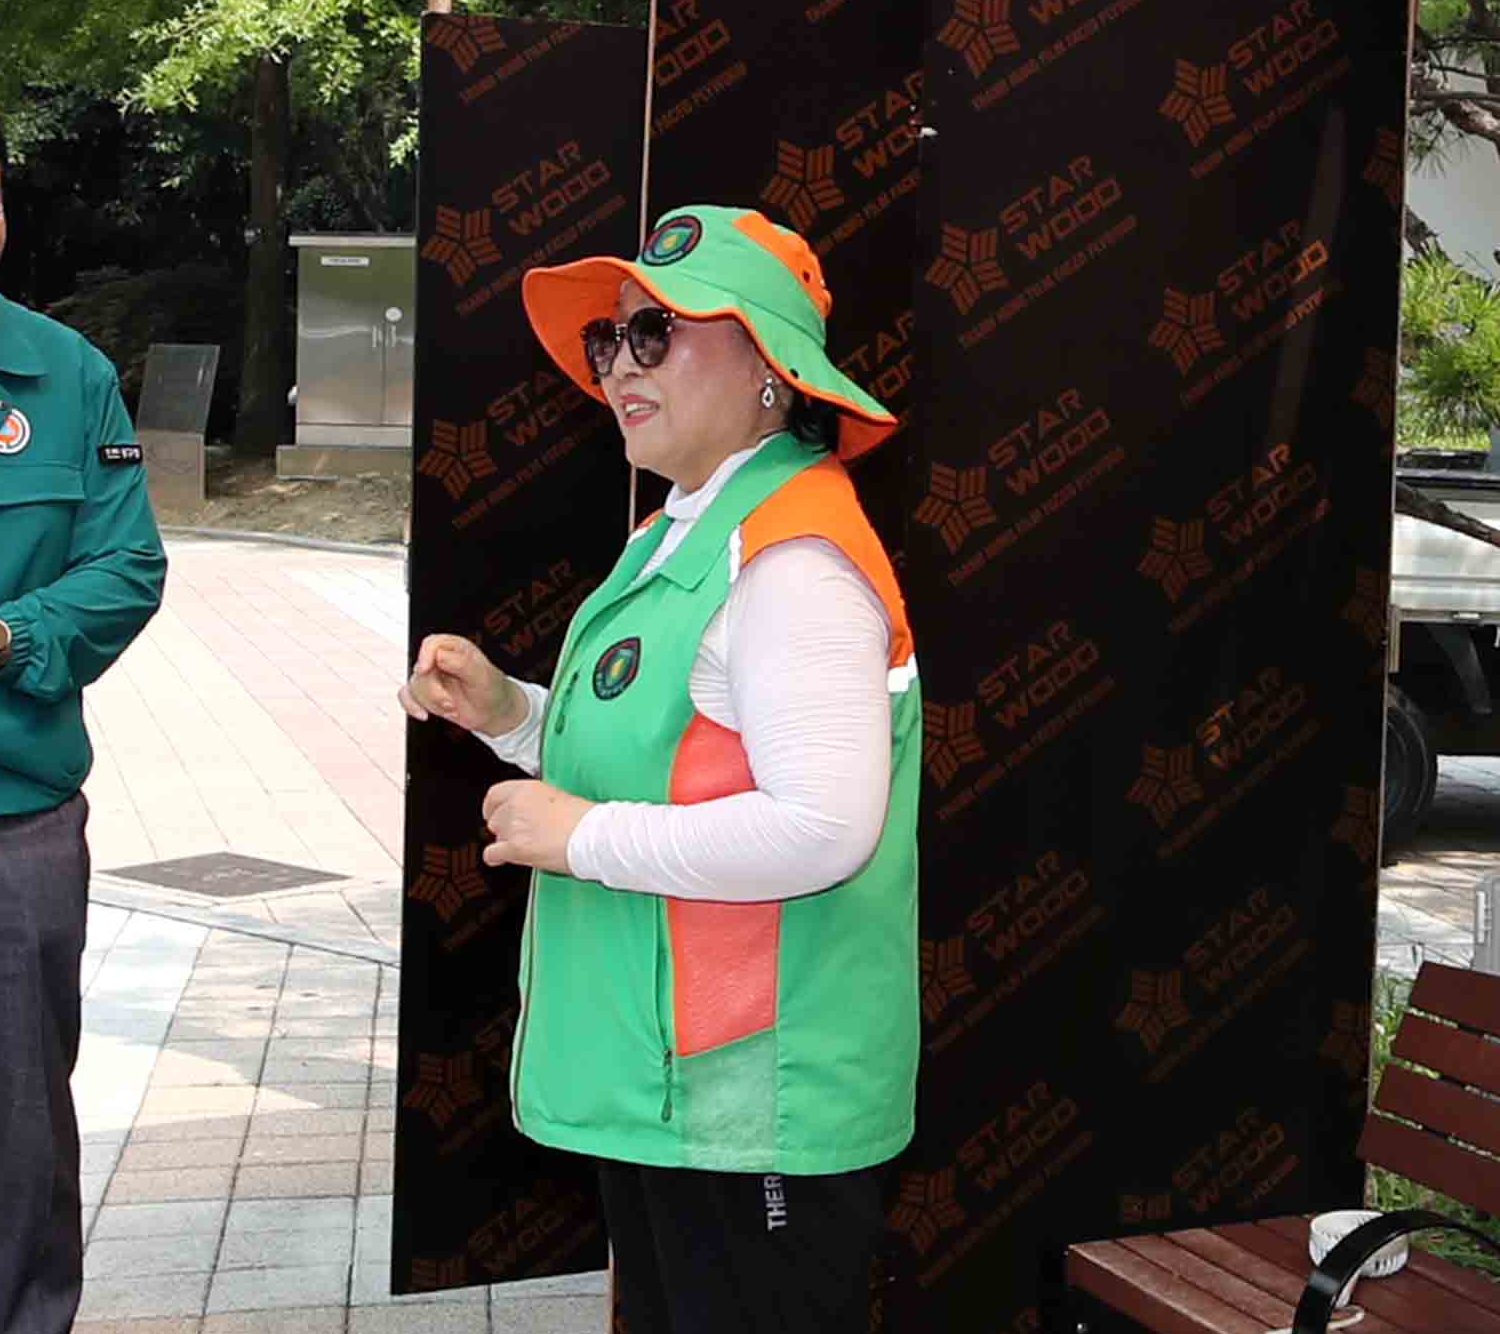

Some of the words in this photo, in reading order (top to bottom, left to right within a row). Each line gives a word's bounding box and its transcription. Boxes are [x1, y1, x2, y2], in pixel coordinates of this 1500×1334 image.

[1243, 18, 1339, 95] WOOD
[491, 139, 581, 213] STAR
[508, 159, 612, 235] WOOD
[999, 155, 1095, 234] STAR
[1017, 178, 1124, 260] WOOD
[1218, 219, 1301, 296] STAR
[1234, 240, 1329, 320] WOOD
[987, 388, 1084, 469] STAR
[1006, 408, 1110, 494] WOOD
[1204, 443, 1291, 522] STAR
[1220, 460, 1317, 543] WOOD
[979, 619, 1070, 704] STAR
[996, 639, 1099, 729] WOOD
[966, 851, 1061, 935] STAR
[957, 1080, 1051, 1167] STAR
